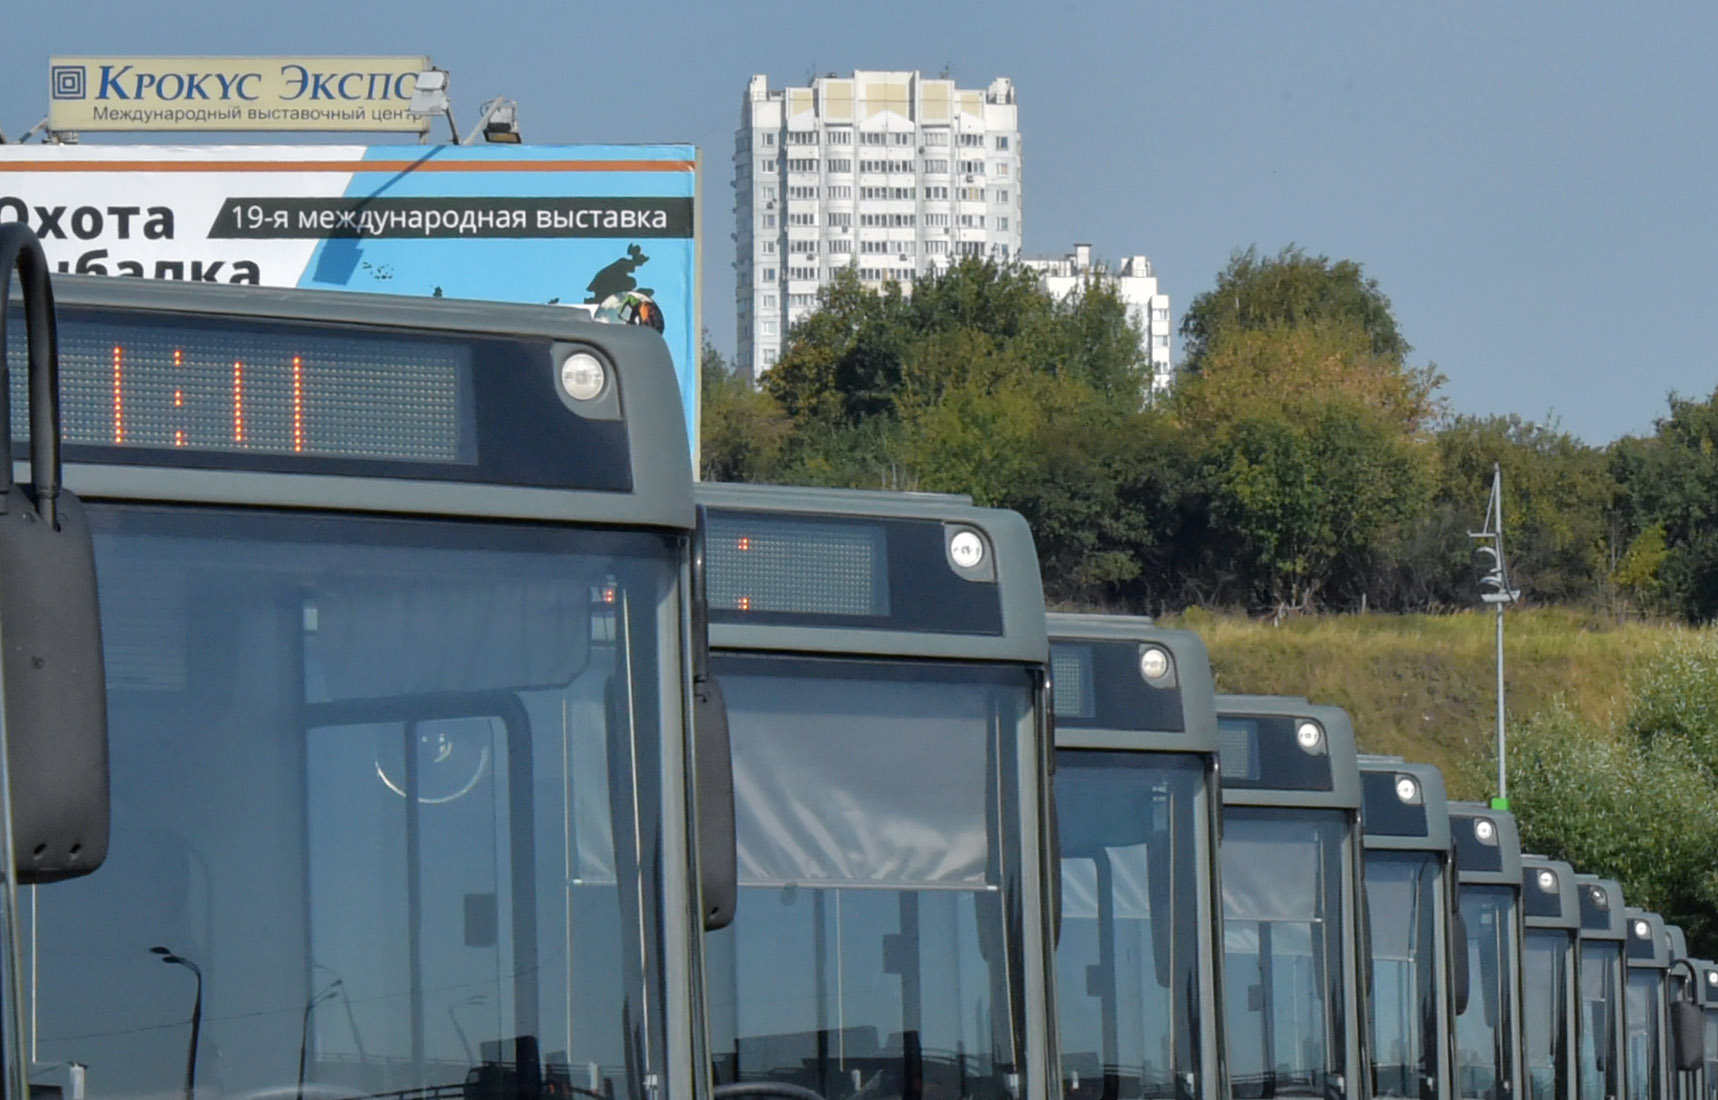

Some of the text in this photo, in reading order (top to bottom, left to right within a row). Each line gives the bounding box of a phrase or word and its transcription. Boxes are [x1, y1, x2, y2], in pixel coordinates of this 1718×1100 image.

[93, 106, 241, 124] Международный
[248, 107, 366, 121] выставочный
[232, 205, 667, 236] 19-я международная выставка
